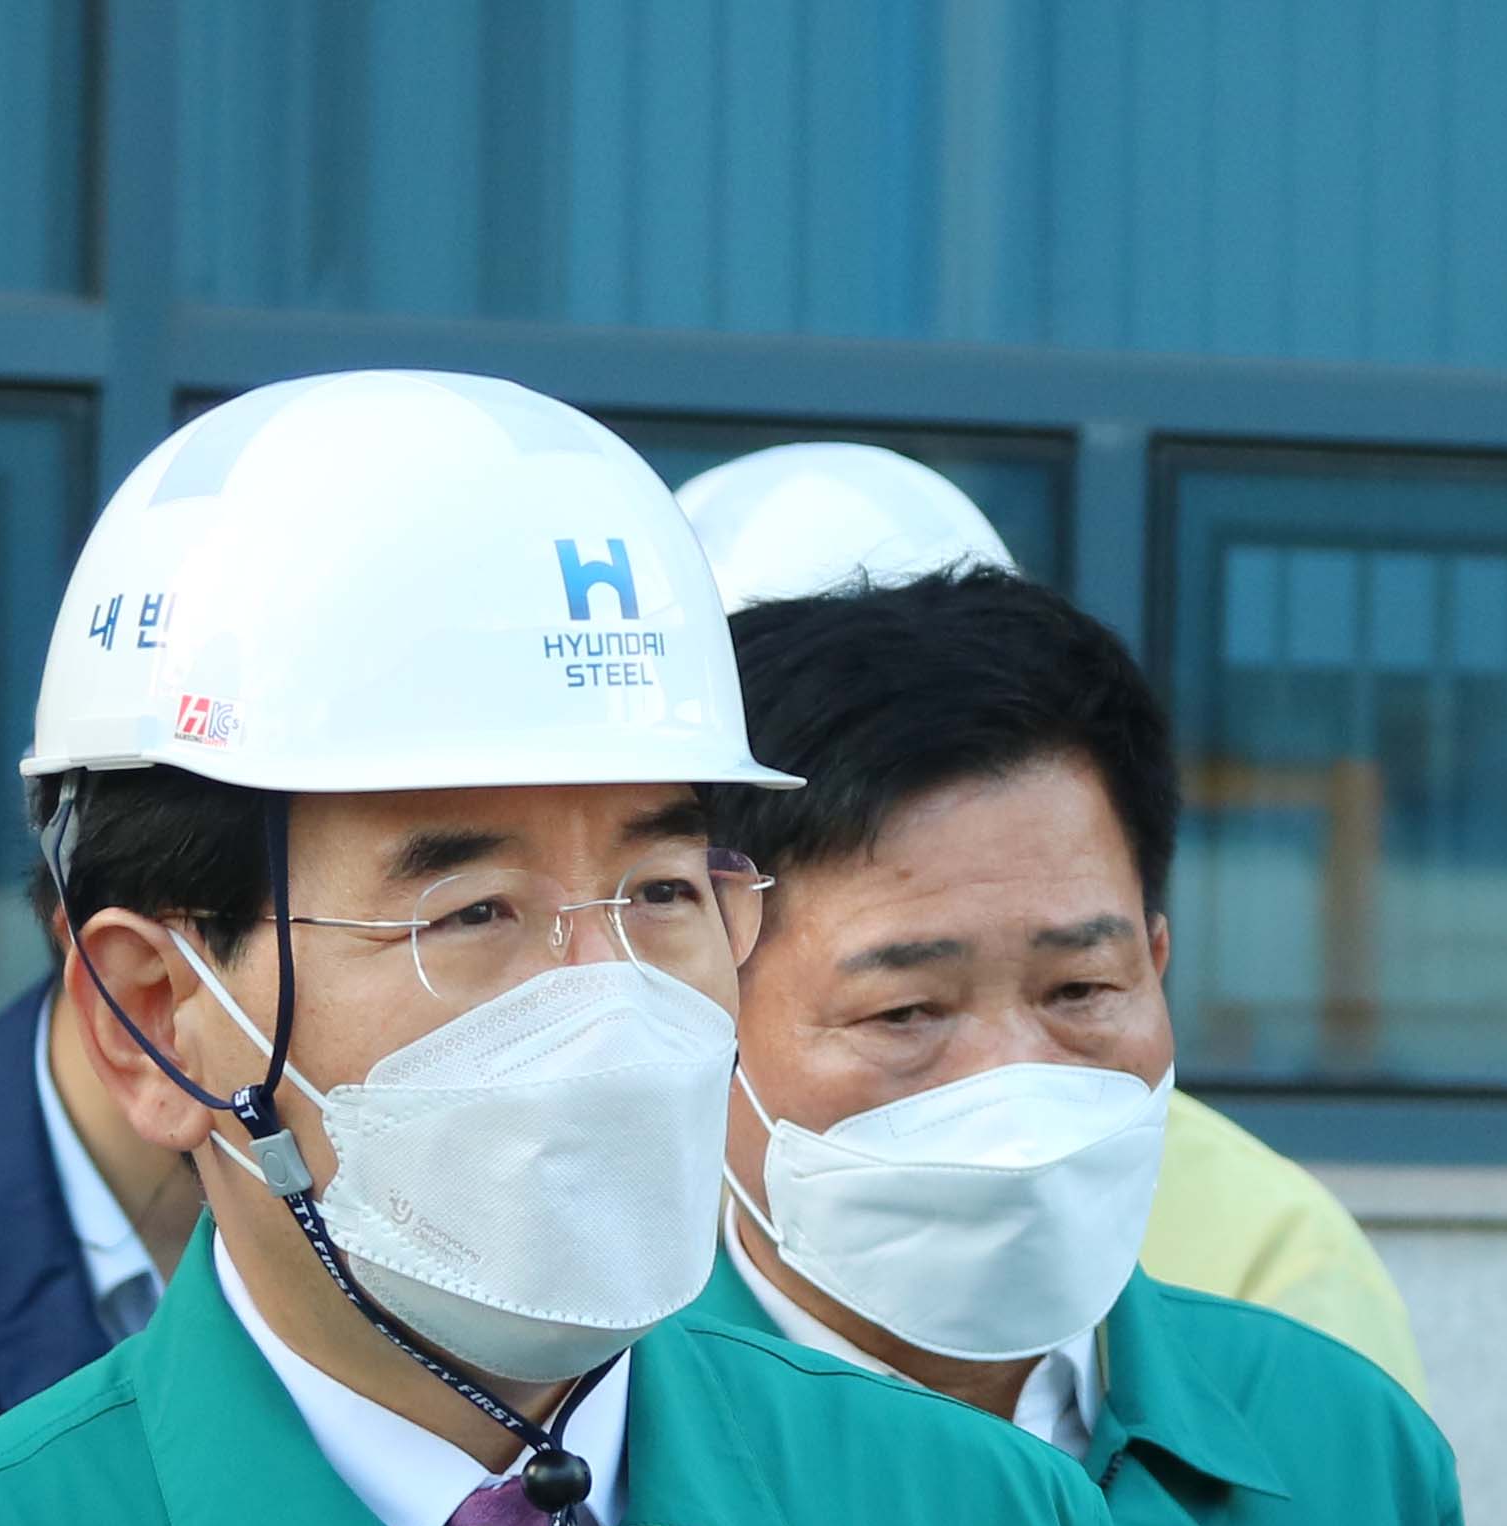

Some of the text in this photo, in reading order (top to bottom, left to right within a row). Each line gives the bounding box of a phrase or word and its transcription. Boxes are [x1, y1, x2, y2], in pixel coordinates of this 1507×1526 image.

[543, 631, 665, 659] HYUNDAI
[565, 661, 654, 688] STEEL
[457, 1382, 523, 1429] FIRST
